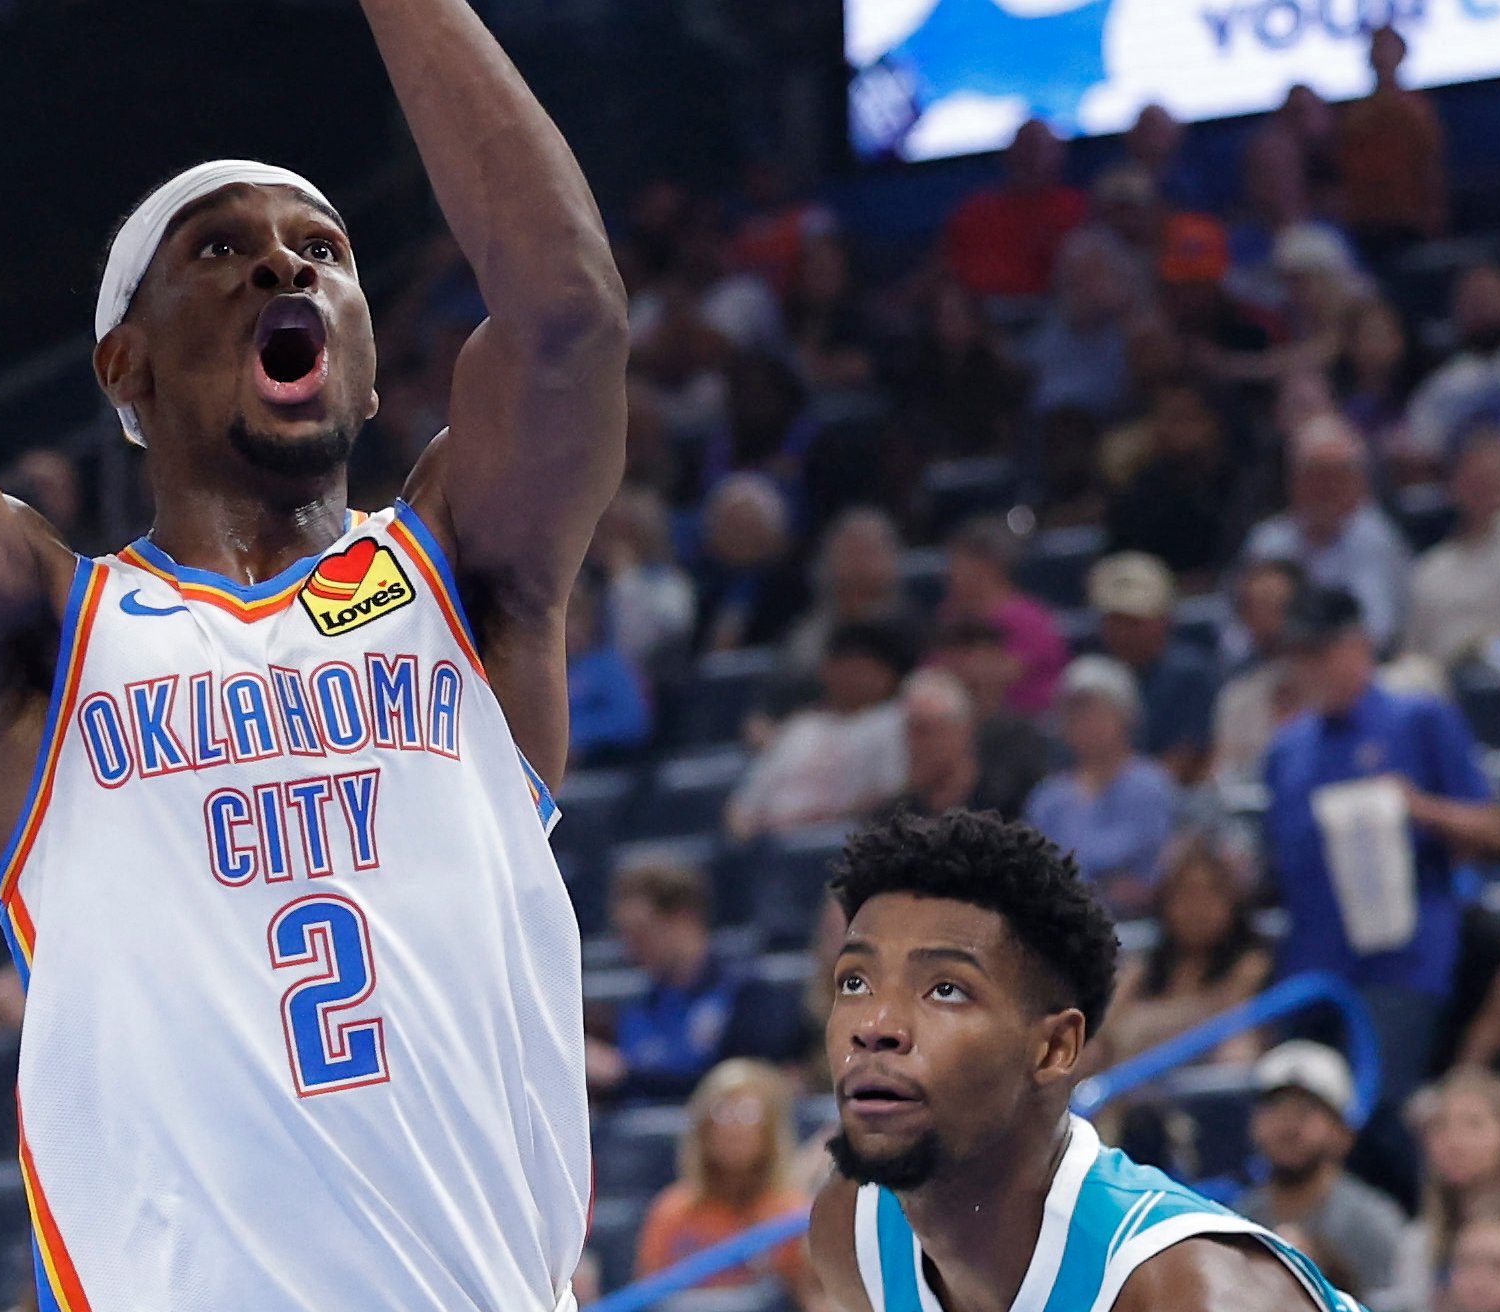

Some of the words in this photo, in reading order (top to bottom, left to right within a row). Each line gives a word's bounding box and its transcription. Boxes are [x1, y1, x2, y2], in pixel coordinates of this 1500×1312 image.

[78, 652, 463, 789] OKLAHOMA
[204, 768, 380, 887] CITY
[267, 893, 391, 1097] 2
